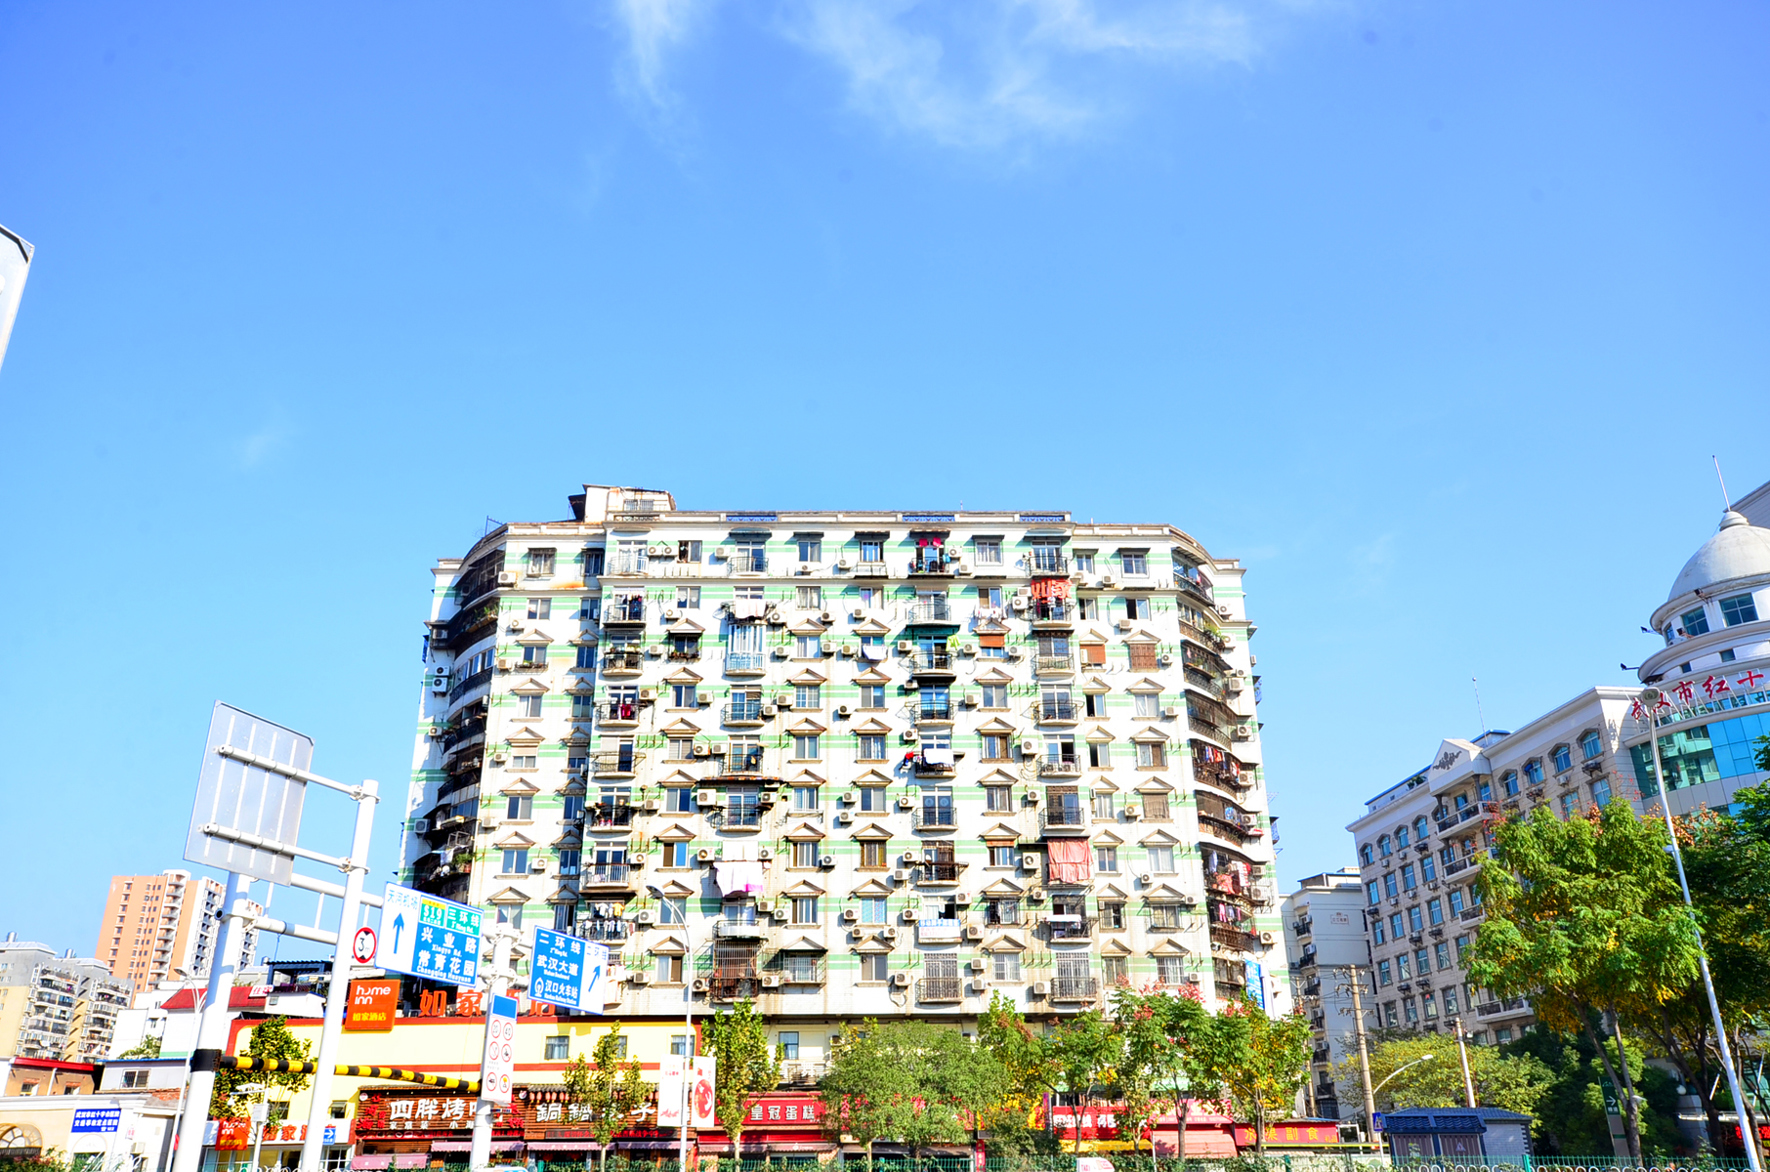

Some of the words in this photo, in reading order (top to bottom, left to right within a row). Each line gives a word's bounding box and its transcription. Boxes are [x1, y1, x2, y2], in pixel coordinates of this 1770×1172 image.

[423, 904, 443, 920] S19
[448, 908, 480, 927] 三环线
[421, 926, 478, 954] 兴业路
[539, 932, 581, 955] 二环线
[418, 949, 476, 977] 常青花园
[537, 954, 579, 976] 武汉大道
[356, 985, 391, 995] home
[545, 979, 578, 999] 汉口火车站
[352, 1012, 387, 1022] 如家酒店
[750, 1104, 815, 1121] 皇冠蛋糕
[1244, 1126, 1319, 1141] 水果副食
